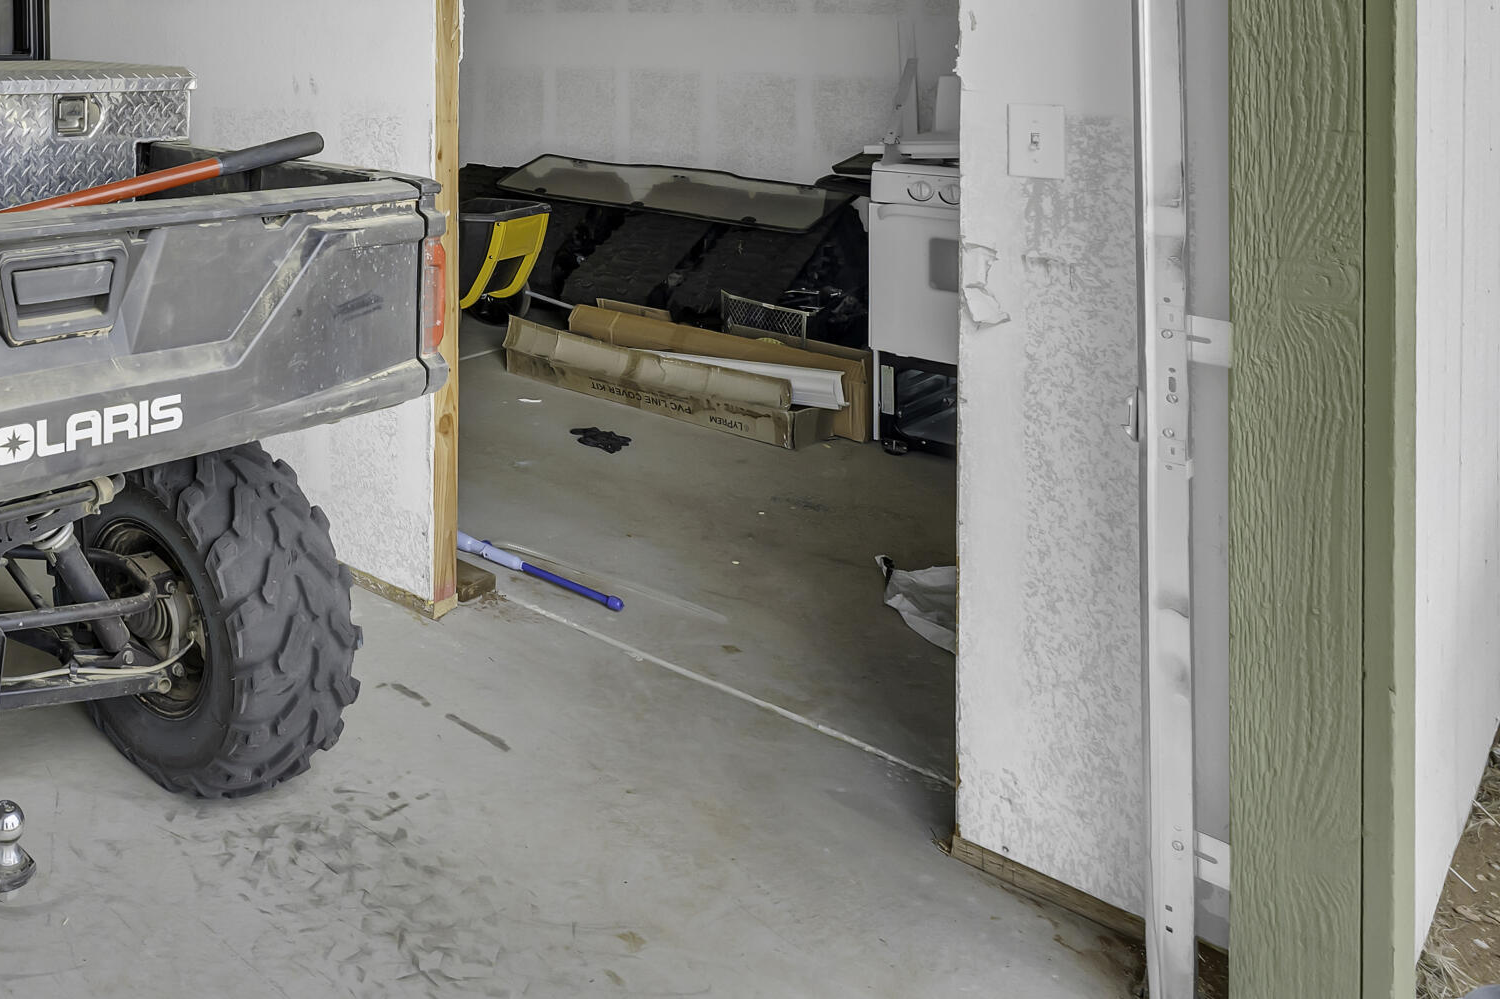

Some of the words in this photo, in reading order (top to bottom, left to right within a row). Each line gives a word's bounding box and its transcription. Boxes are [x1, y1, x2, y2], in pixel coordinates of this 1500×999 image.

[591, 381, 606, 392] KIT
[608, 386, 642, 401] COVER
[645, 393, 667, 406] LINE
[670, 402, 693, 414] PVC
